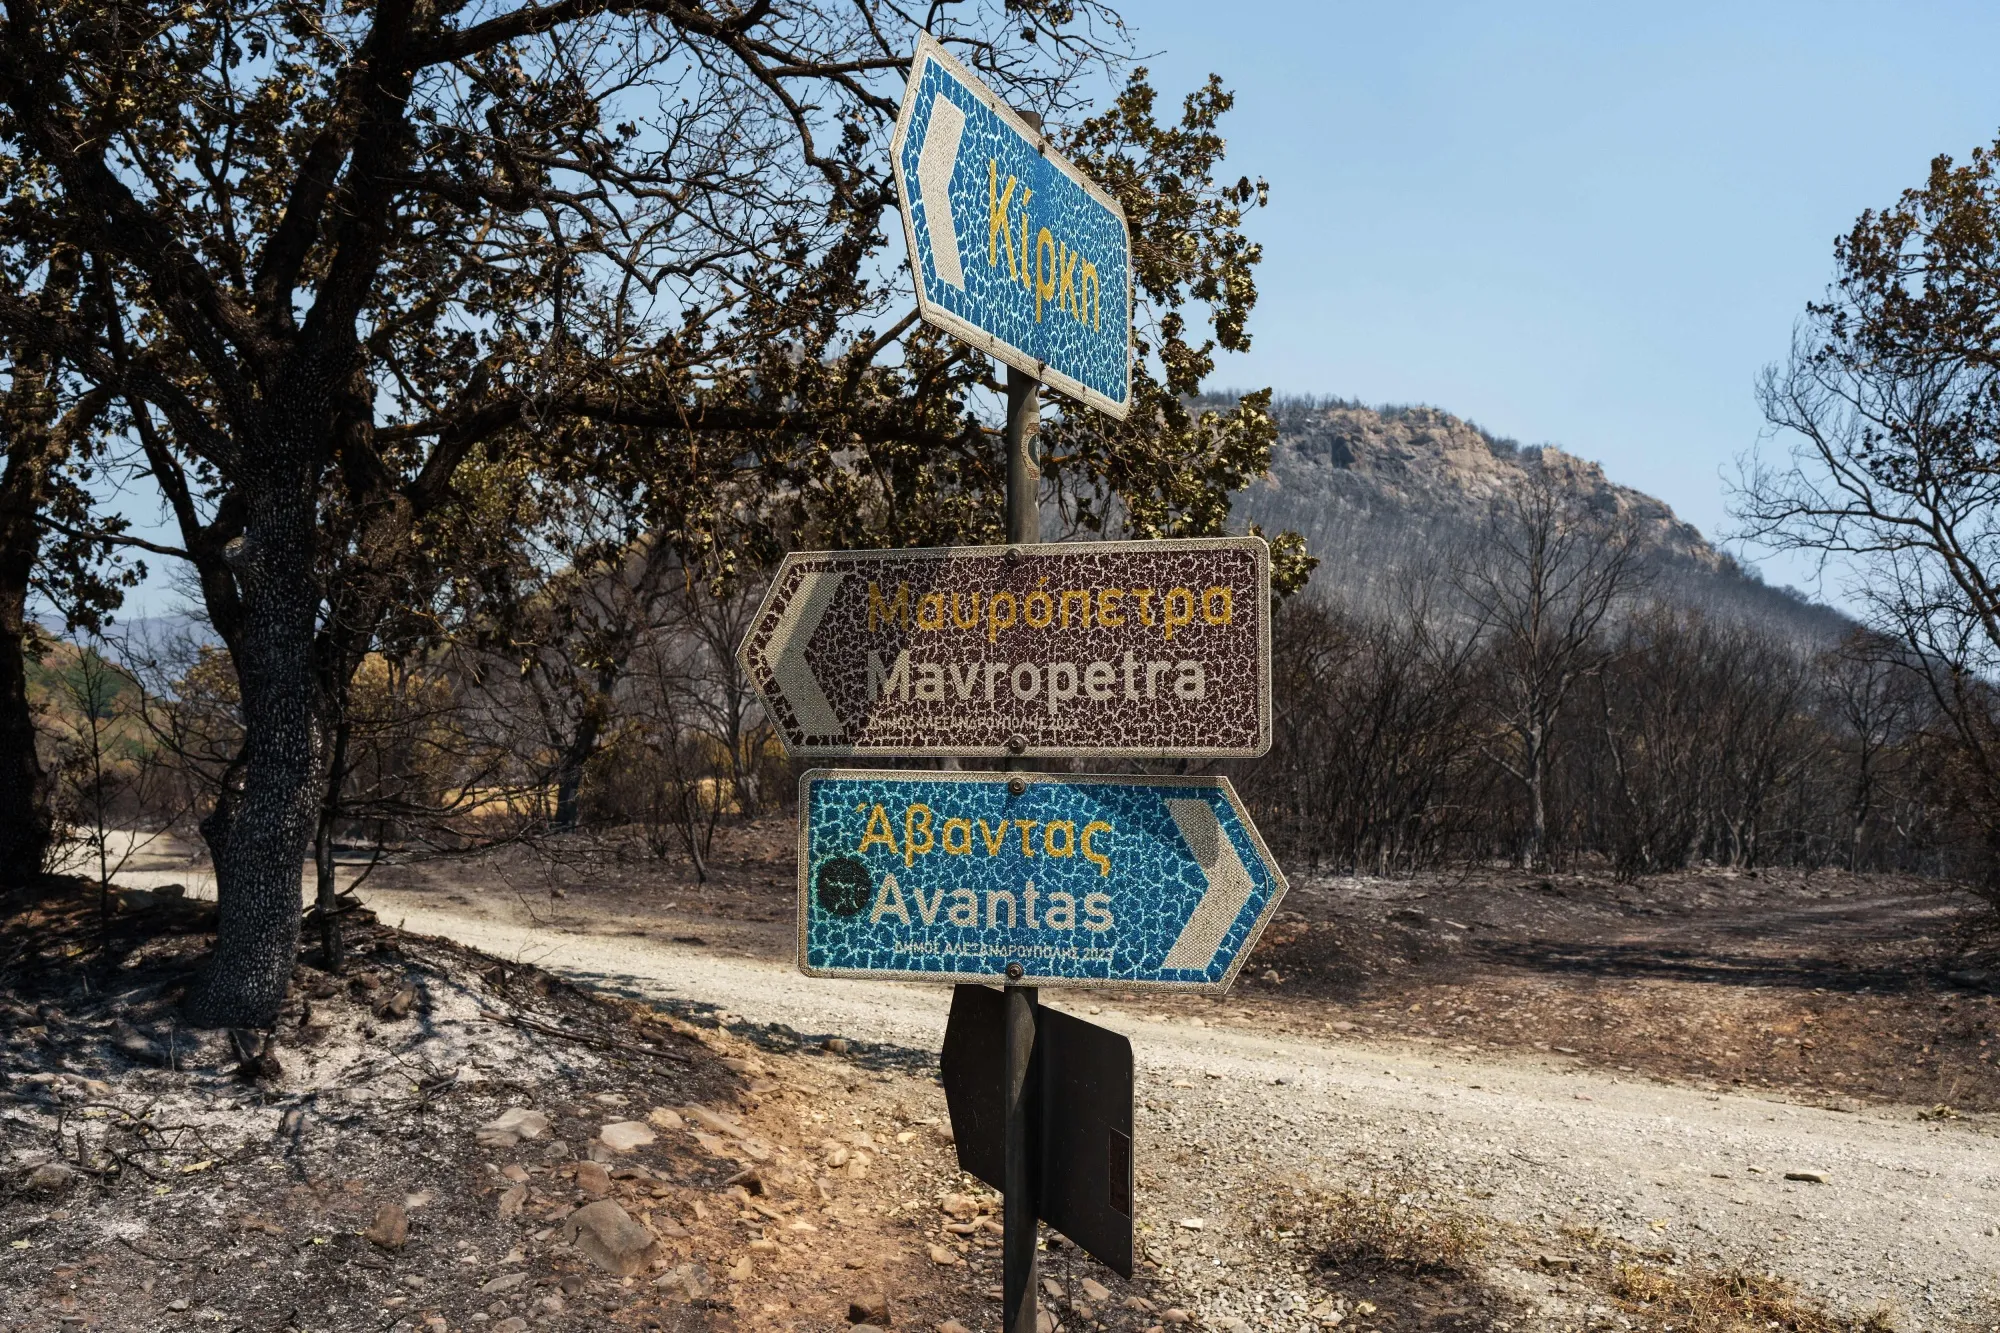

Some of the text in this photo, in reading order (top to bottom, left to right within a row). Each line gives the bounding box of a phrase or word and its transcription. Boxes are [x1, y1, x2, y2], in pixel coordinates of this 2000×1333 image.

[989, 158, 1100, 333] Κίρκη
[867, 577, 1233, 643] Μαυρόπετρα
[867, 648, 1206, 716] Mavropetra
[857, 802, 1113, 878] Άβαντας
[870, 874, 1115, 934] Avantas
[1083, 947, 1113, 960] 2023
